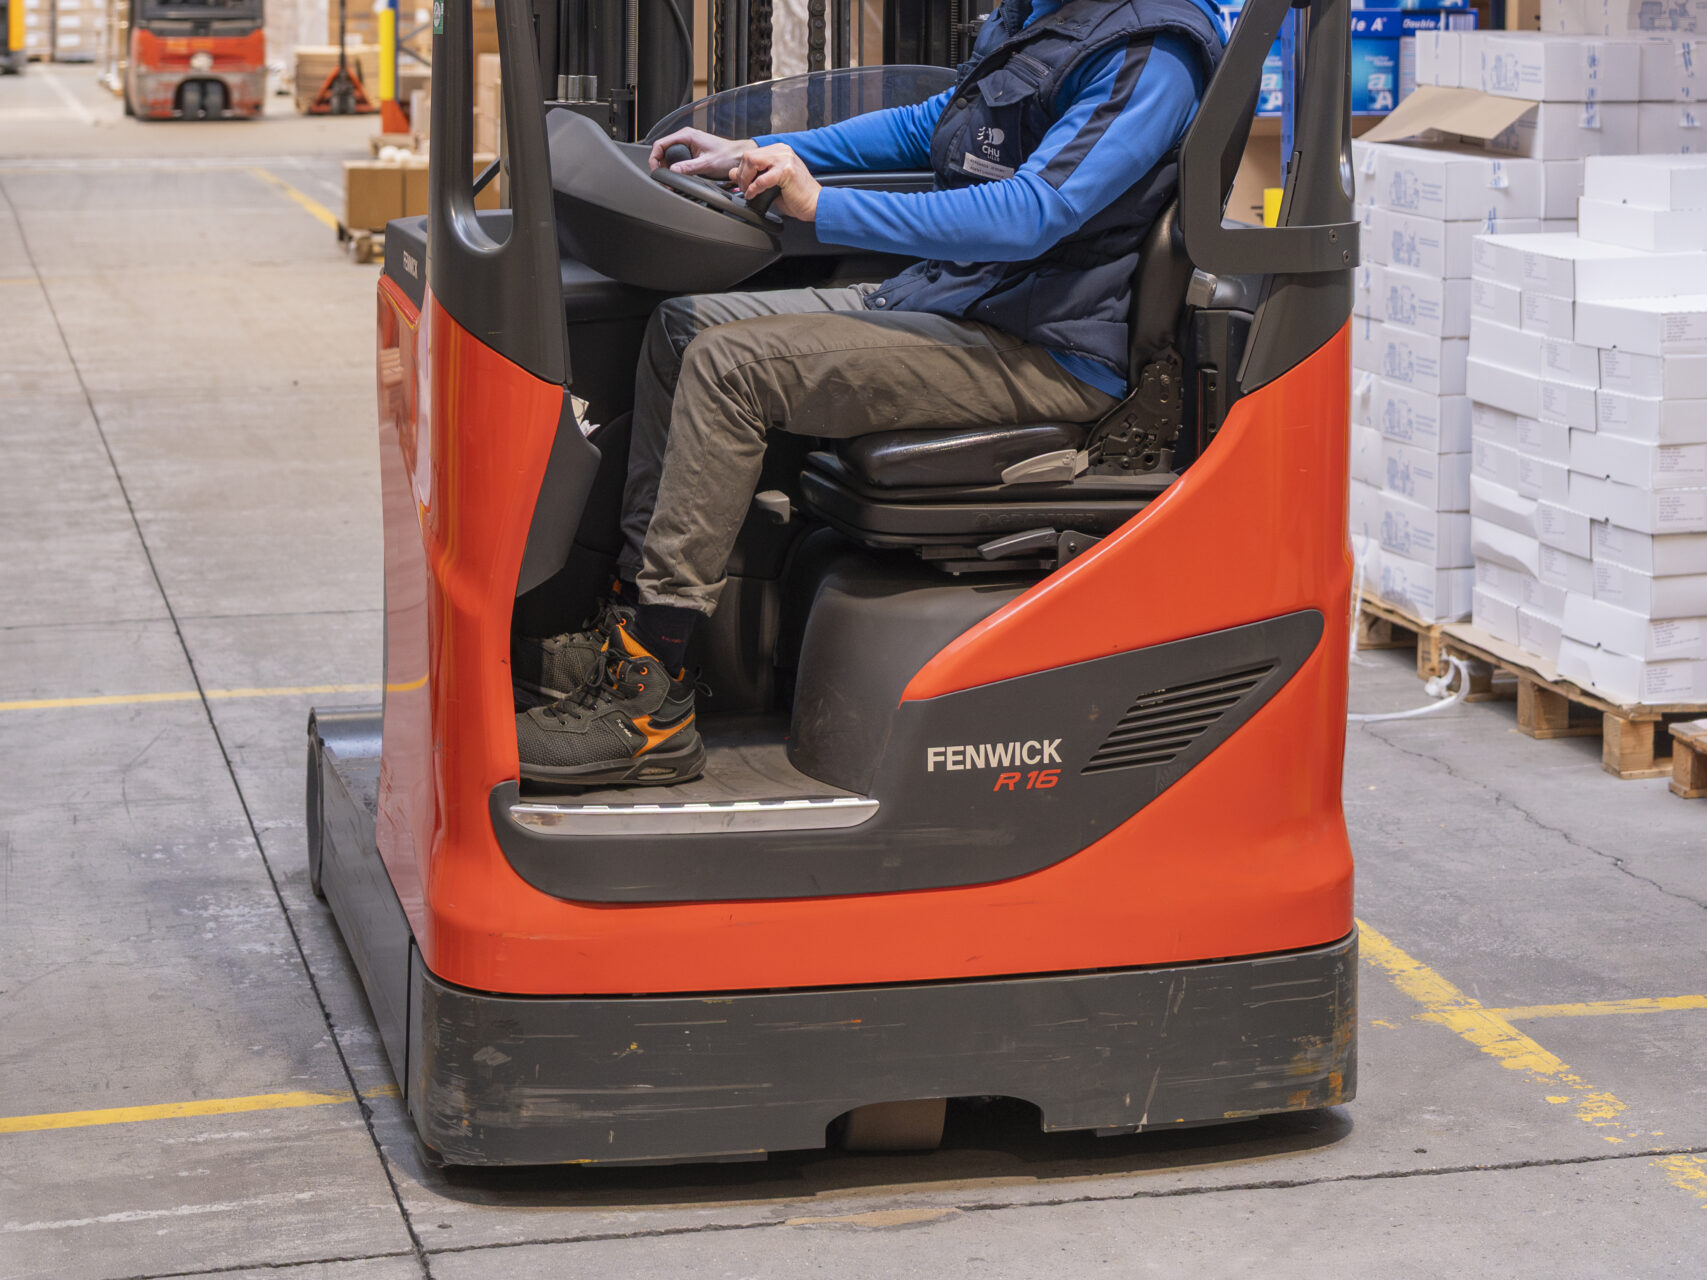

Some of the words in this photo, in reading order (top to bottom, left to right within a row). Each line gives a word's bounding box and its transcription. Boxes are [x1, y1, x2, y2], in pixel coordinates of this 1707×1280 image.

[982, 145, 1000, 158] CHU
[927, 738, 1063, 772] FENWICK
[992, 771, 1022, 792] R
[1025, 769, 1062, 790] 16
